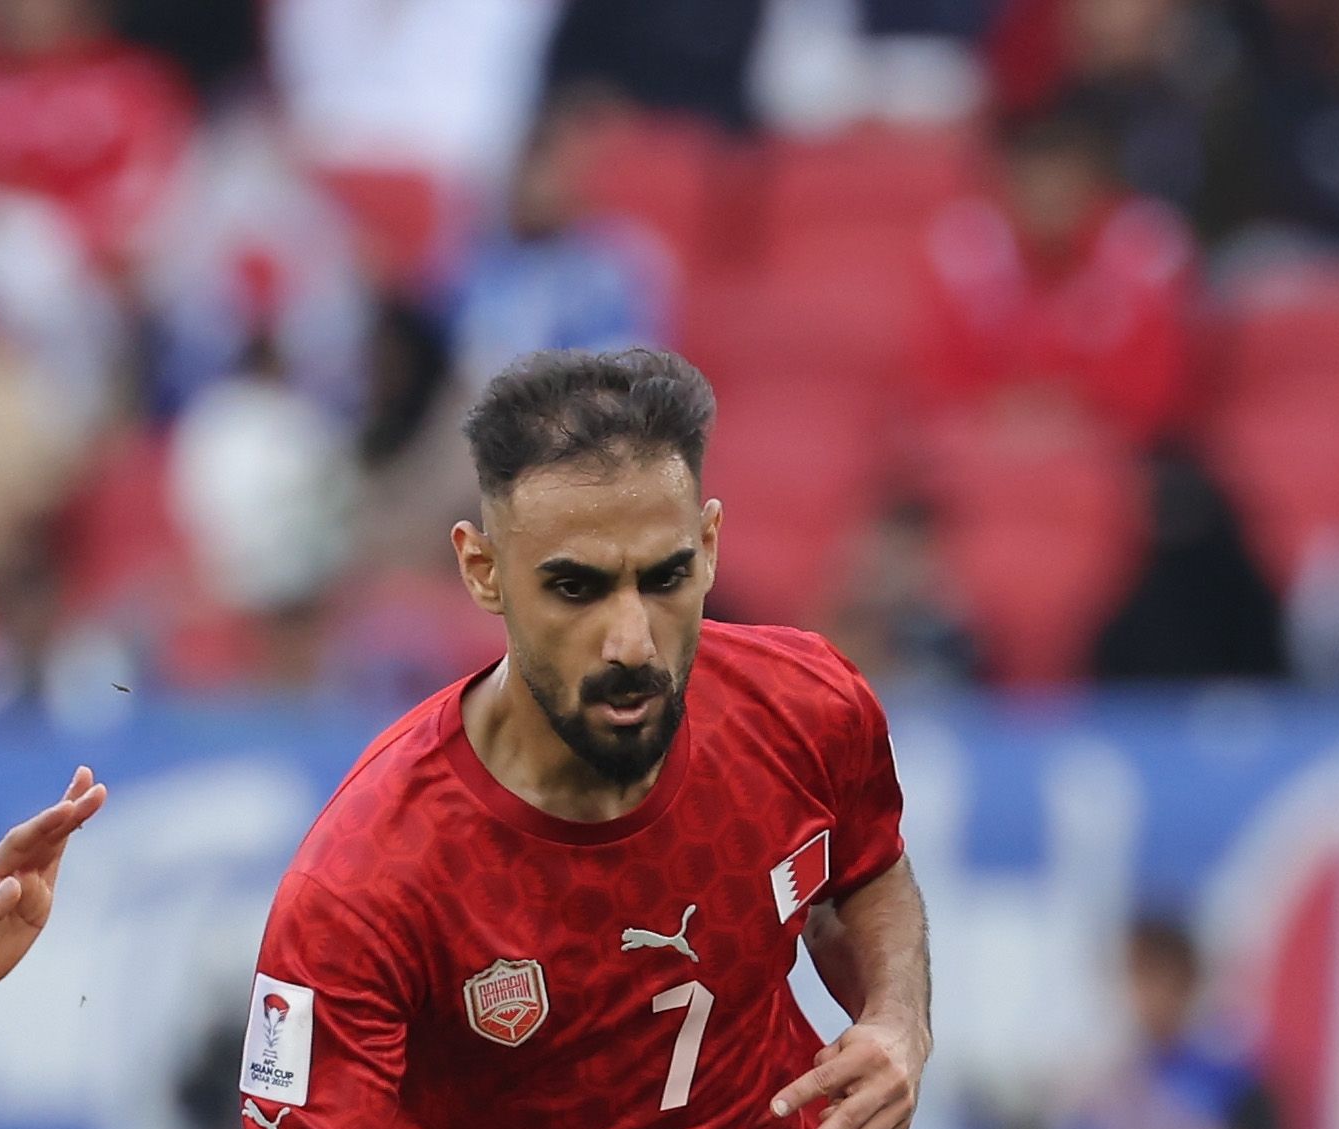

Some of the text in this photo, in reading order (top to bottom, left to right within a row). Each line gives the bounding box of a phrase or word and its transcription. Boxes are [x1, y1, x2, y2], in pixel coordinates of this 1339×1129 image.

[652, 981, 714, 1112] 7
[263, 1059, 275, 1067] AFC
[250, 1062, 294, 1079] ASIAN CUP
[251, 1071, 270, 1083] QATAR
